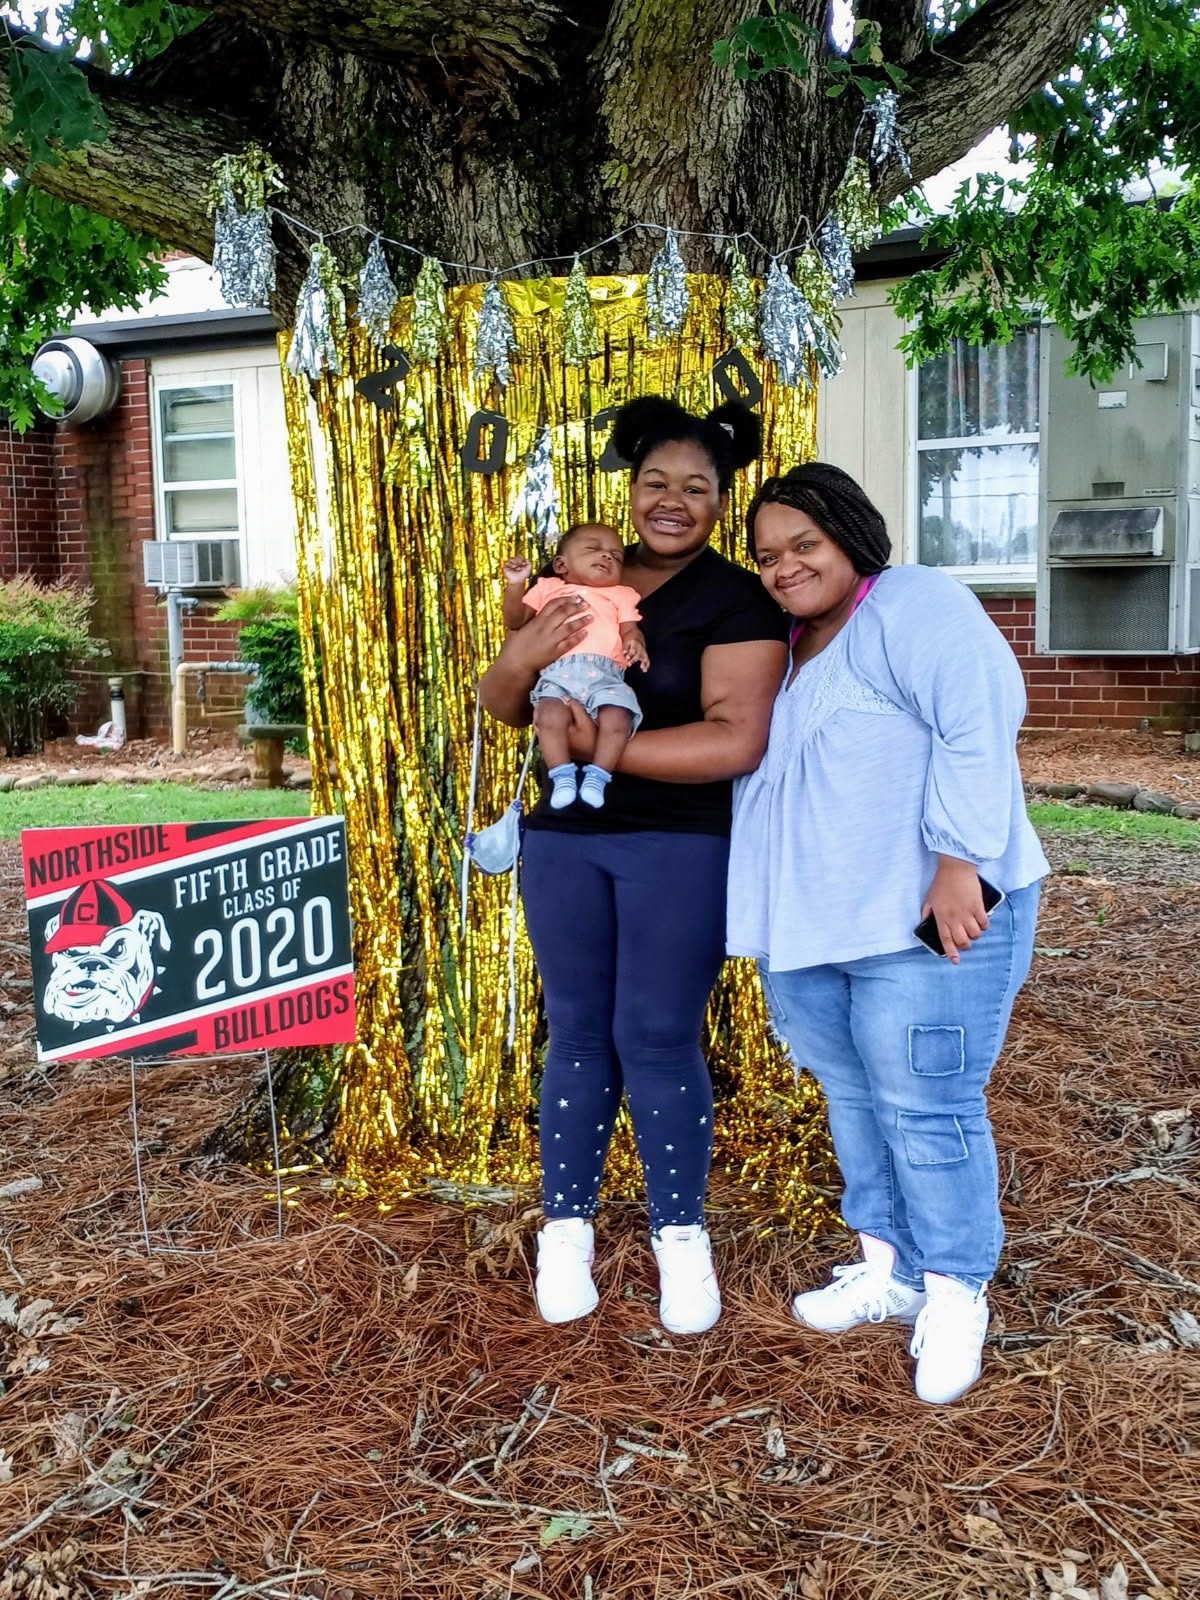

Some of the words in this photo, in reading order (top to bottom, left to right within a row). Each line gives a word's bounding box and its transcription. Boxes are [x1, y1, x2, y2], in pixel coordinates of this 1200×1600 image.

[28, 824, 171, 889] NORTHSIDE
[173, 857, 249, 909] FIFTH
[259, 830, 342, 879] GRADE
[77, 902, 95, 922] C
[222, 886, 276, 920] CLASS
[282, 877, 302, 902] OF
[193, 895, 334, 1001] 2020
[213, 980, 350, 1050] BULLDOGS
